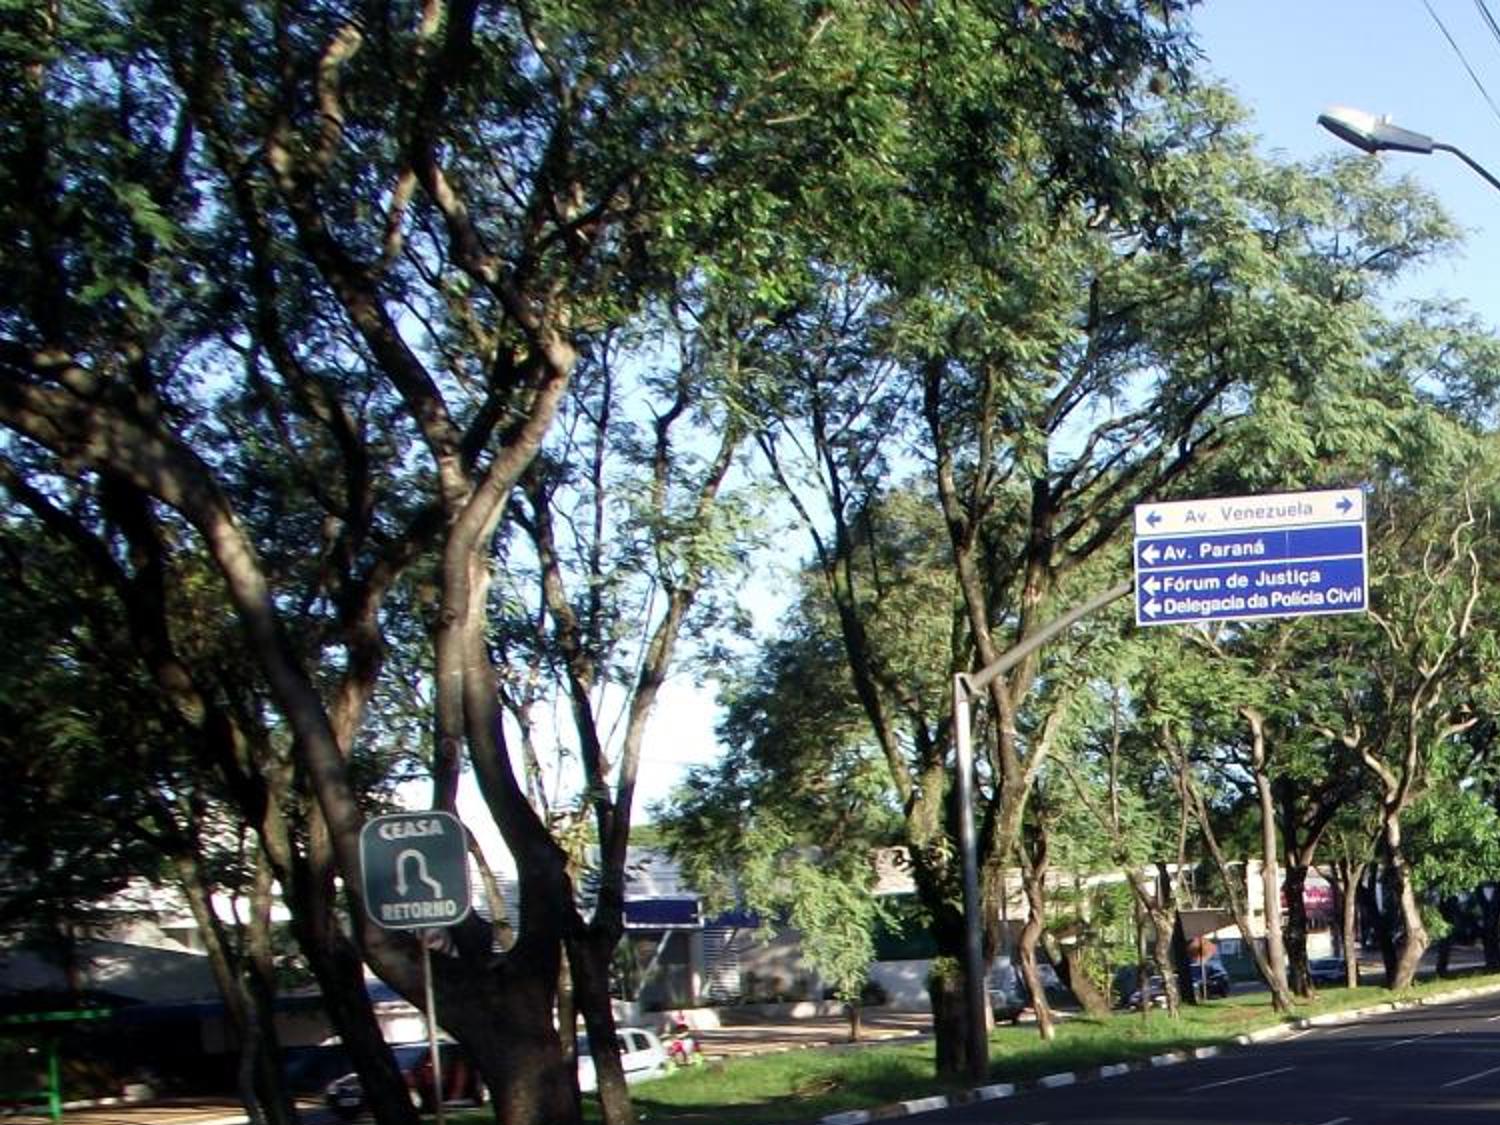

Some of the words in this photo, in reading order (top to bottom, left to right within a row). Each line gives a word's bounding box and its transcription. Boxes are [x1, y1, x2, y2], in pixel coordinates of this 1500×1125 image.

[1220, 502, 1313, 521] Venezuela
[1163, 545, 1192, 561] Av.
[1199, 540, 1265, 558] Paraná
[1163, 577, 1220, 593] Fórum
[1226, 573, 1248, 588] de
[1255, 569, 1320, 587] Justiça
[1163, 595, 1245, 615] Delegacia
[1247, 593, 1268, 609] da
[1271, 591, 1325, 607] Polícia
[1326, 587, 1361, 604] Civil
[378, 820, 444, 840] CEASA
[381, 900, 457, 920] RETORNO
